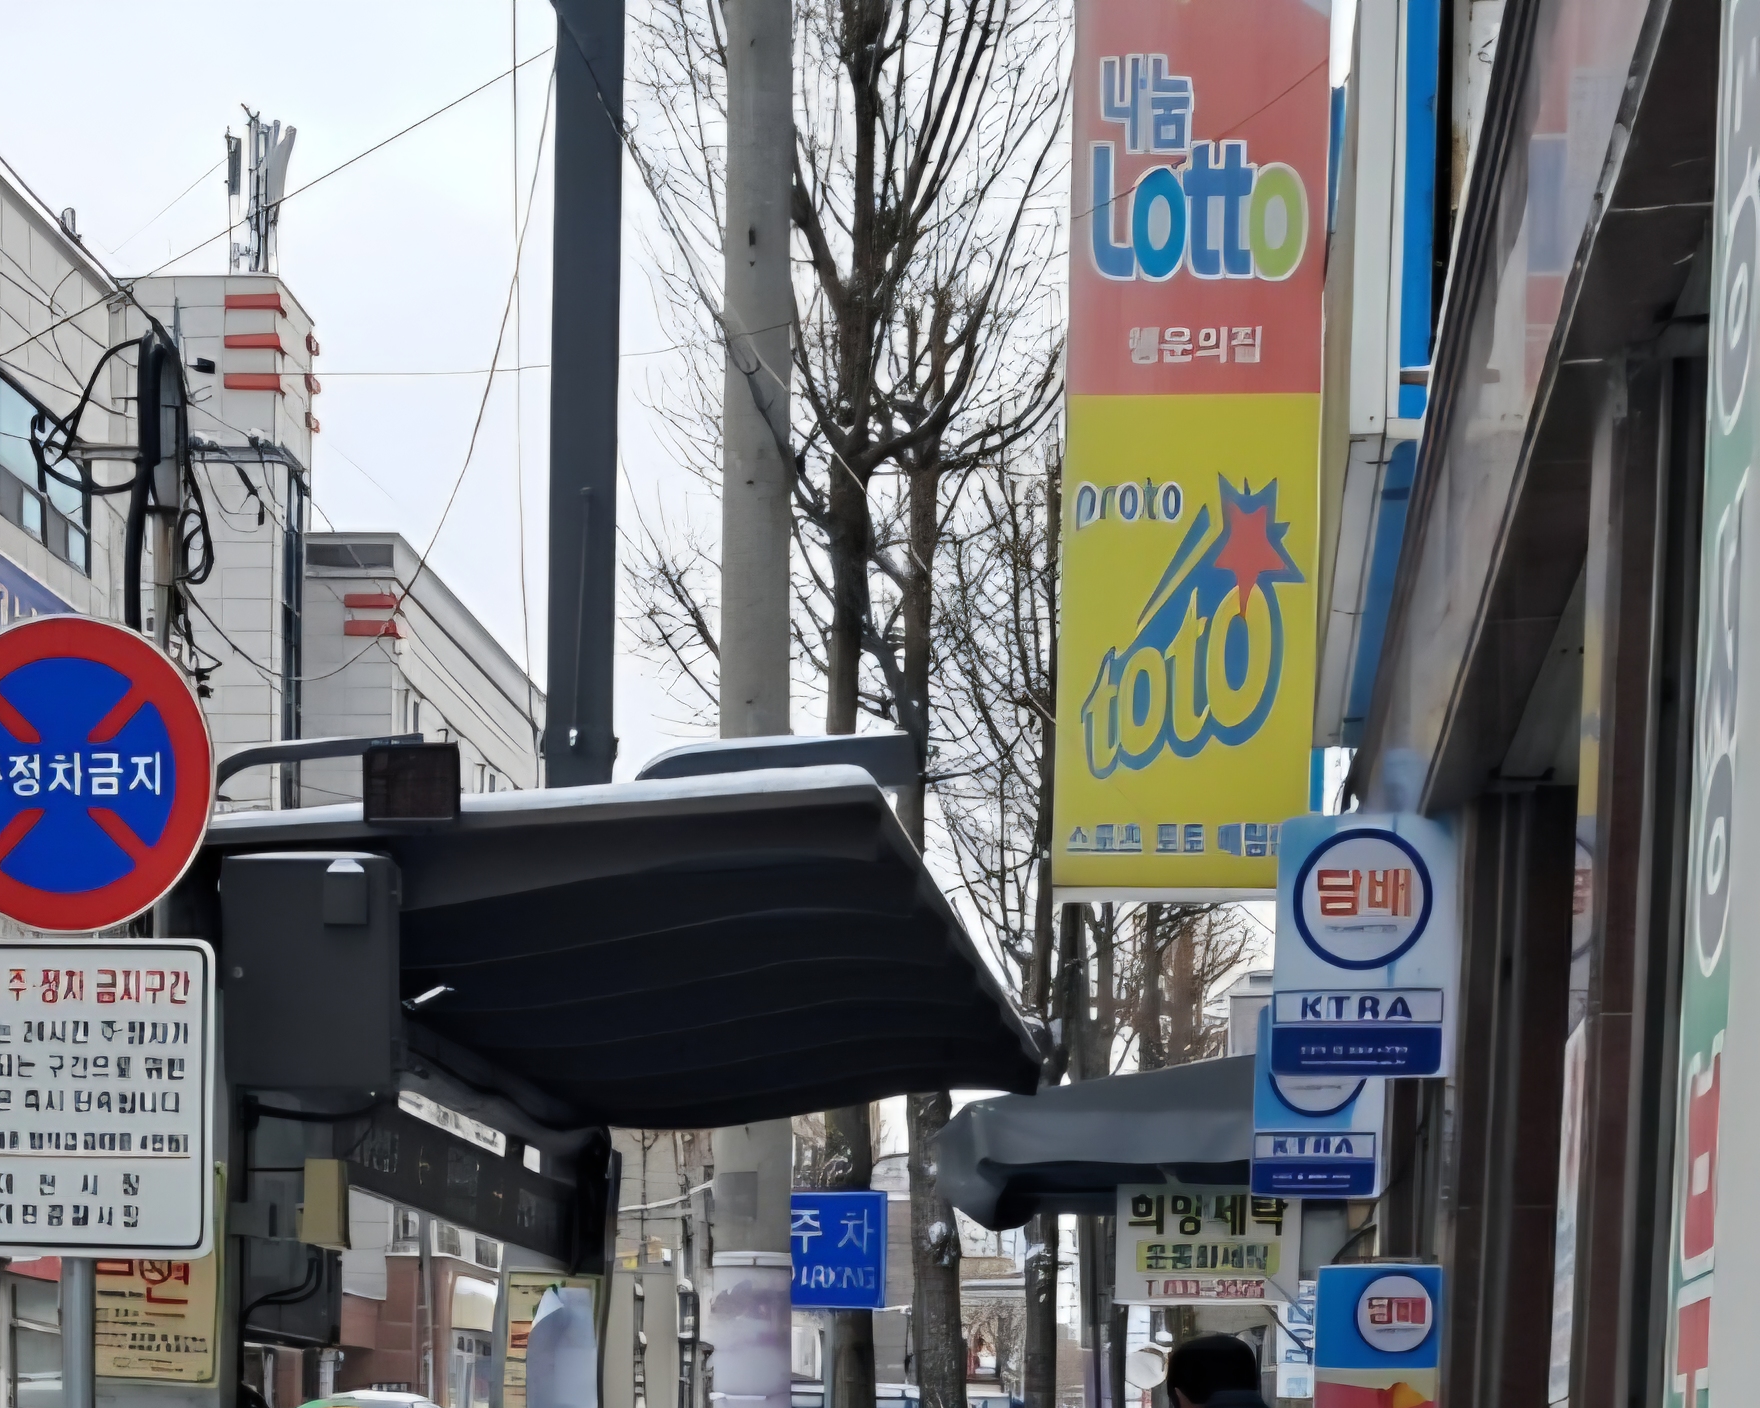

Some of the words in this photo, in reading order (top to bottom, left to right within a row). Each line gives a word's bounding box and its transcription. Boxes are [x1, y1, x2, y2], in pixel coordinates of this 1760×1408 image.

[1090, 139, 1309, 281] Lotto
[1076, 480, 1184, 531] proto
[1082, 583, 1284, 779] toto
[790, 1209, 874, 1255] 주차
